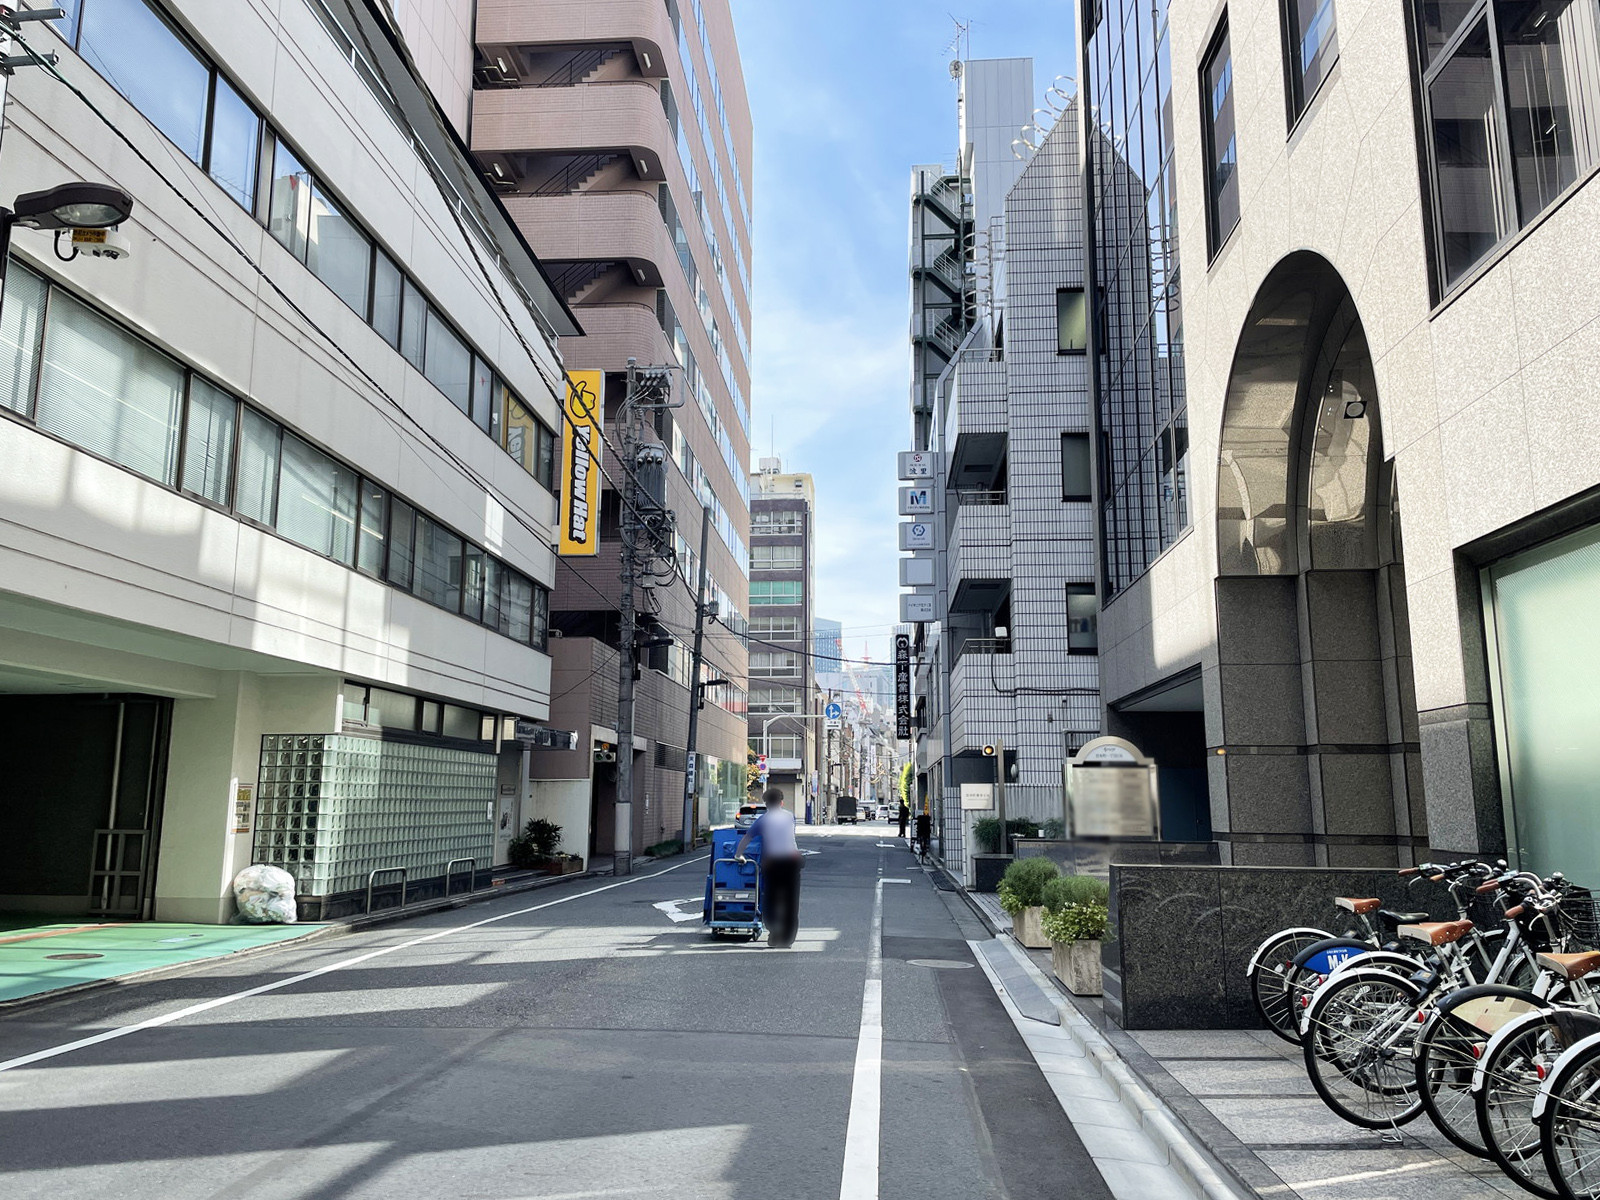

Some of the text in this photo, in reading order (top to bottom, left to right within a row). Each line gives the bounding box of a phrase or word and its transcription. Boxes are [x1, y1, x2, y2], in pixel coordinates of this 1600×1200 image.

[897, 650, 909, 736] 森下産業株式会社
